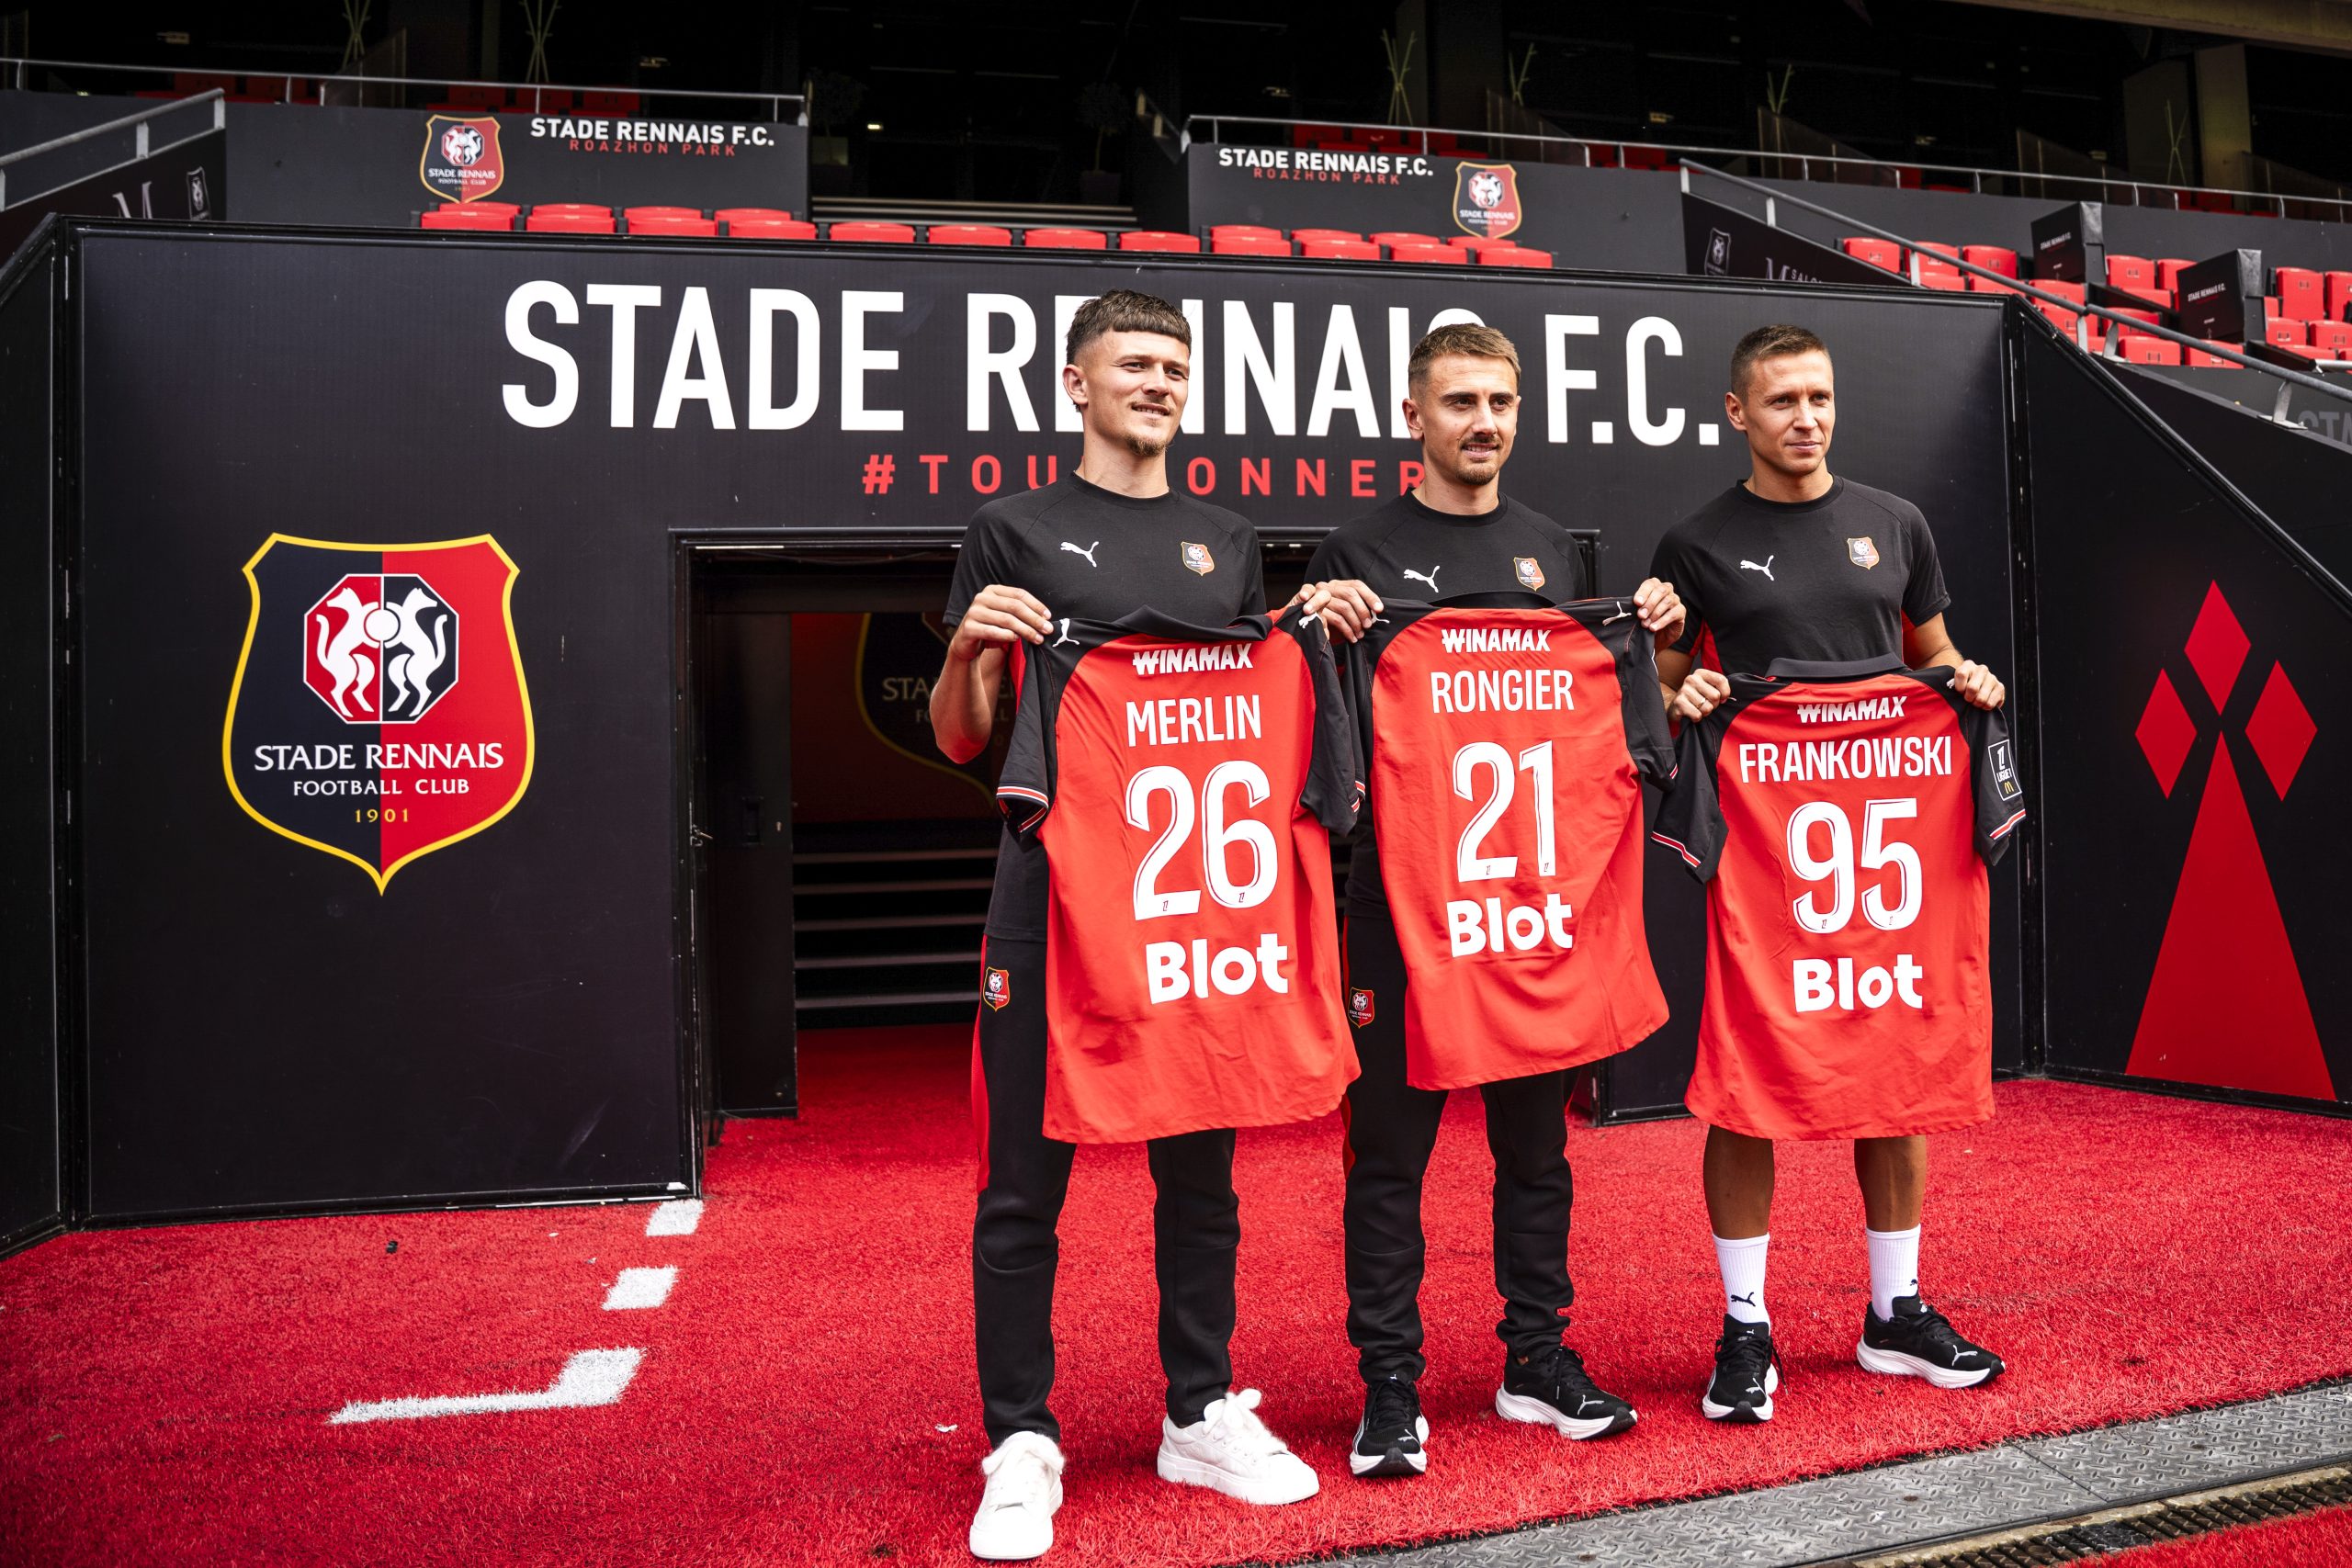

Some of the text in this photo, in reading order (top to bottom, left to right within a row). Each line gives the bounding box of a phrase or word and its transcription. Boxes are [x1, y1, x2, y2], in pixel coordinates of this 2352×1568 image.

[530, 117, 775, 147] STADE RENNAIS F.C.
[569, 139, 736, 157] ROAZHON PARK
[427, 167, 496, 179] STADE RENNAIS
[1218, 147, 1434, 176] STADE RENNAIS F.C.
[1253, 167, 1400, 186] ROAZHON PARK
[502, 280, 904, 432] STADE
[1545, 314, 1719, 446] F.C.
[862, 453, 1425, 497] #TOUONNER
[1442, 628, 1553, 653] WINAMAX
[1132, 643, 1253, 676] WINAMAX
[882, 677, 937, 701] STA
[1430, 669, 1575, 714] RONGIER
[1125, 694, 1262, 747] MERLIN
[1797, 696, 1907, 724] WINAMAX
[254, 741, 504, 772] STADE RENNAIS
[1739, 736, 1952, 784] FRANKOWSKI
[293, 778, 470, 796] FOOTBALL CLUB
[354, 808, 410, 824] 1901
[1452, 740, 1556, 884] 21
[1125, 760, 1279, 921] 26
[1786, 797, 1924, 934] 95
[1446, 893, 1574, 958] Blot
[1145, 932, 1289, 1005] Blot
[1792, 953, 1924, 1012] Blot
